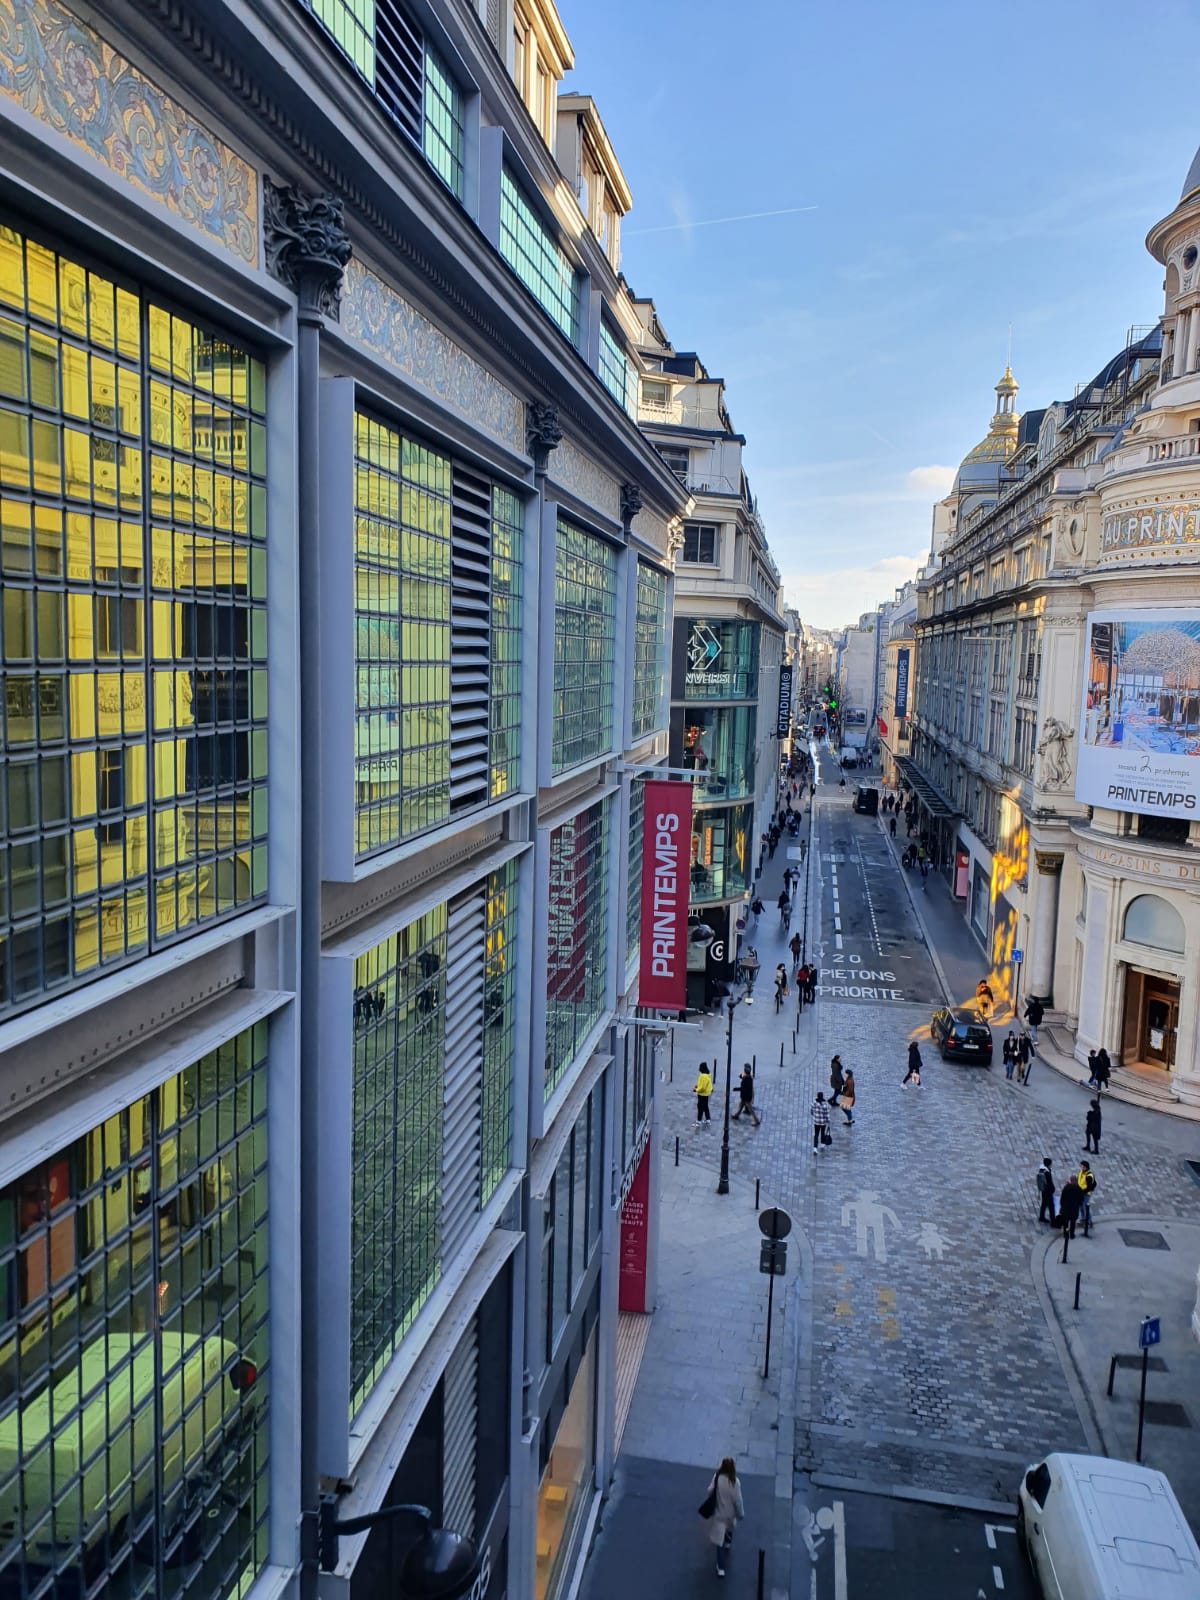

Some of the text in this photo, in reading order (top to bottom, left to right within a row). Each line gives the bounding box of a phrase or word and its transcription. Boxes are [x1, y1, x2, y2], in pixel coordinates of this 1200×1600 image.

[1104, 519, 1121, 547] AU
[897, 659, 908, 707] PRINTEMPS
[1154, 768, 1190, 778] printemps
[1107, 785, 1197, 809] PRINTEMPS
[651, 813, 680, 978] PRINTEMPS
[832, 953, 861, 964] 20
[820, 968, 897, 982] PIETONS
[819, 985, 905, 1001] PRIORITE
